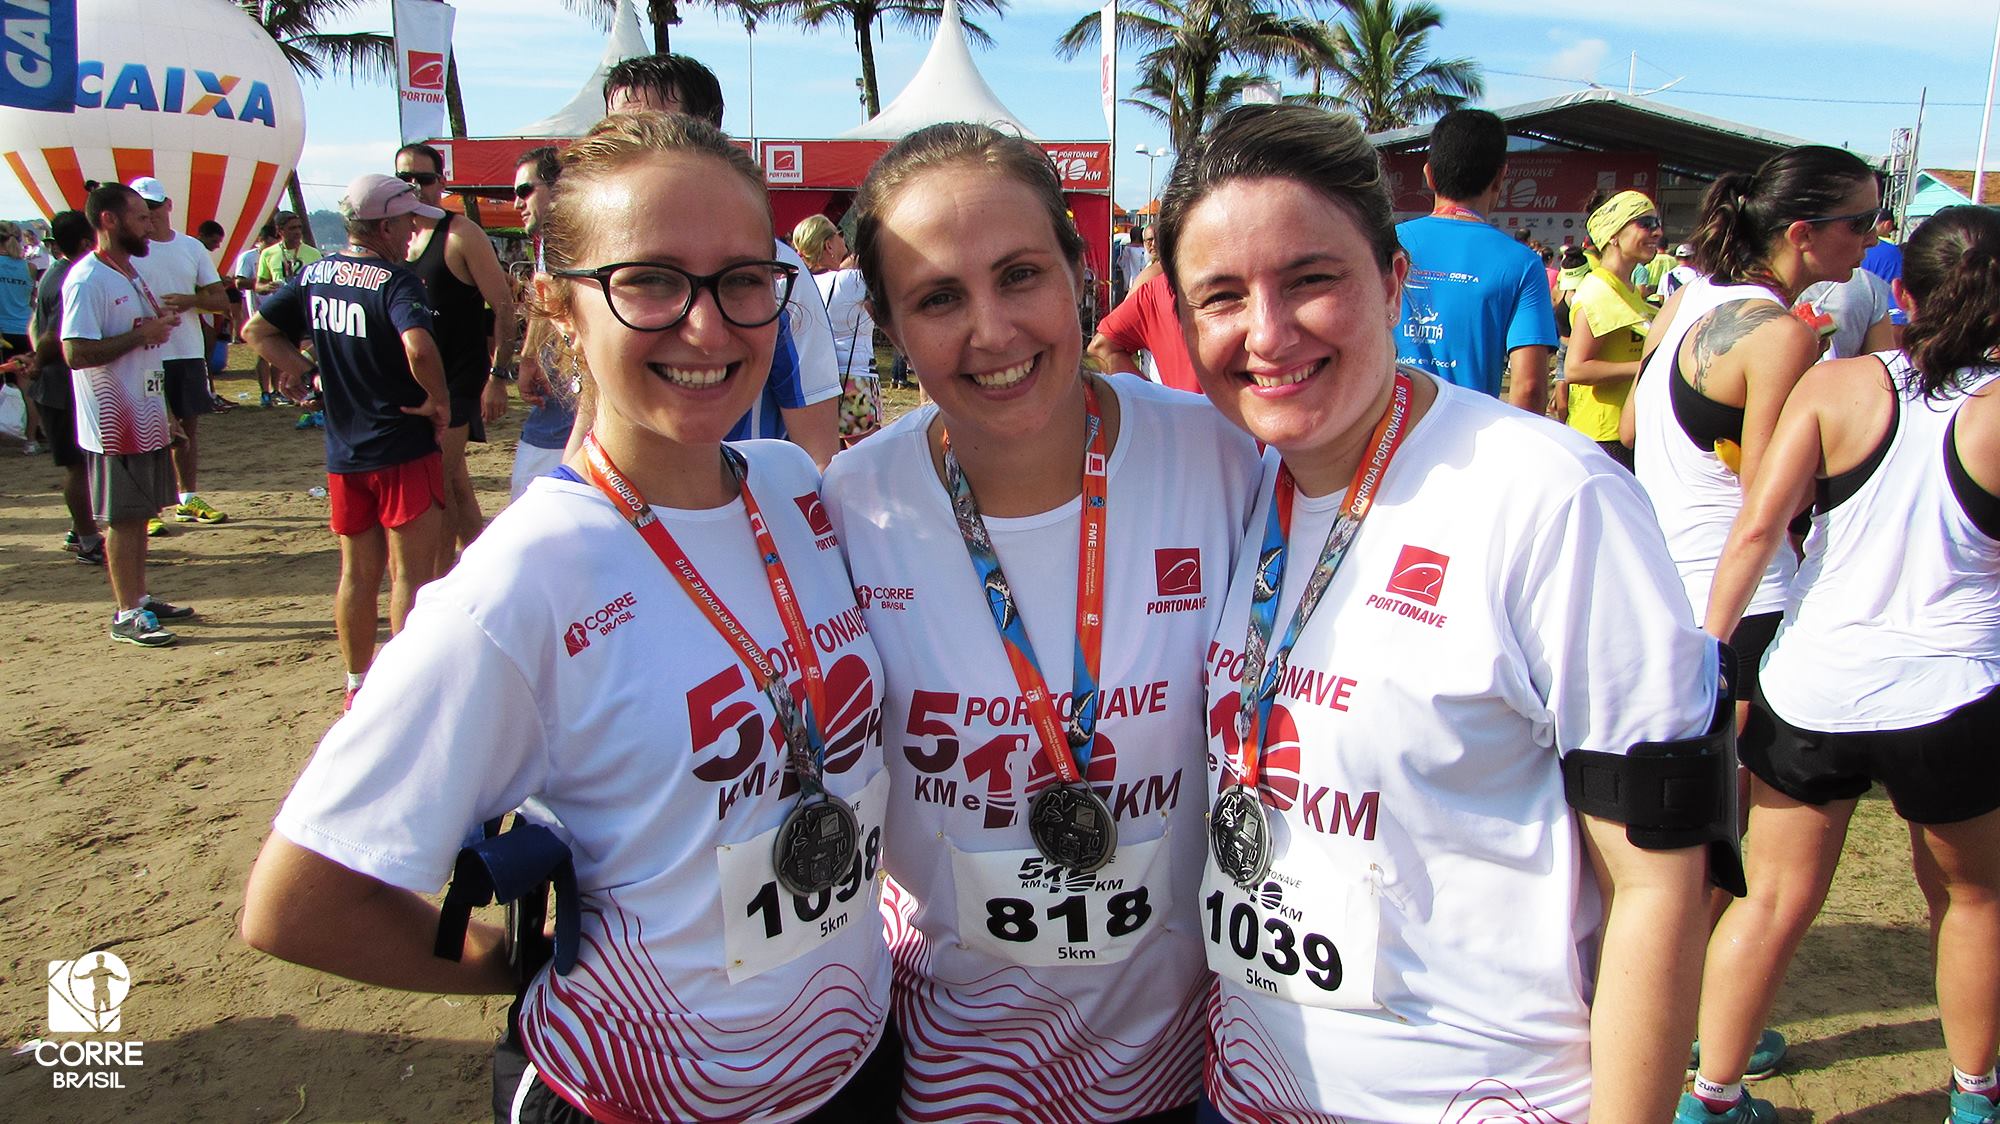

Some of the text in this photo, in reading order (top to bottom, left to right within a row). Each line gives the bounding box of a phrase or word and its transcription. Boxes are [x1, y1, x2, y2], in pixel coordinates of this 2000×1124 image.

[76, 61, 276, 128] CAIXA
[1058, 151, 1098, 159] PORTONAVE
[1085, 171, 1101, 180] KM
[1505, 168, 1555, 177] ORTONAVE
[1533, 196, 1557, 208] KM
[301, 260, 392, 291] NAVSHIP
[1350, 467, 1380, 514] CORRIDA
[1372, 404, 1405, 467] PORTONAVE
[606, 469, 643, 511] CORRIDA
[1088, 523, 1098, 547] FME
[774, 578, 791, 603] FME
[873, 587, 914, 600] CORRE
[585, 592, 637, 630] CORRE
[675, 559, 773, 677] CORRIDA PORTONAVE 2018
[881, 601, 906, 610] BRASIL
[1147, 597, 1207, 615] PORTONAVE
[1366, 594, 1447, 628] PORTONAVE
[600, 611, 636, 636] BRASIL
[686, 664, 764, 783] 5
[902, 689, 960, 774] 5
[1114, 768, 1183, 823] KM
[1303, 782, 1380, 841] KM
[1018, 857, 1044, 880] 5
[1094, 879, 1124, 892] KM
[820, 911, 848, 938] 5km
[986, 885, 1152, 943] 818
[1280, 904, 1303, 922] KM
[1058, 946, 1096, 960] 5km
[1206, 890, 1343, 993] 1039
[1245, 968, 1279, 994] 5km
